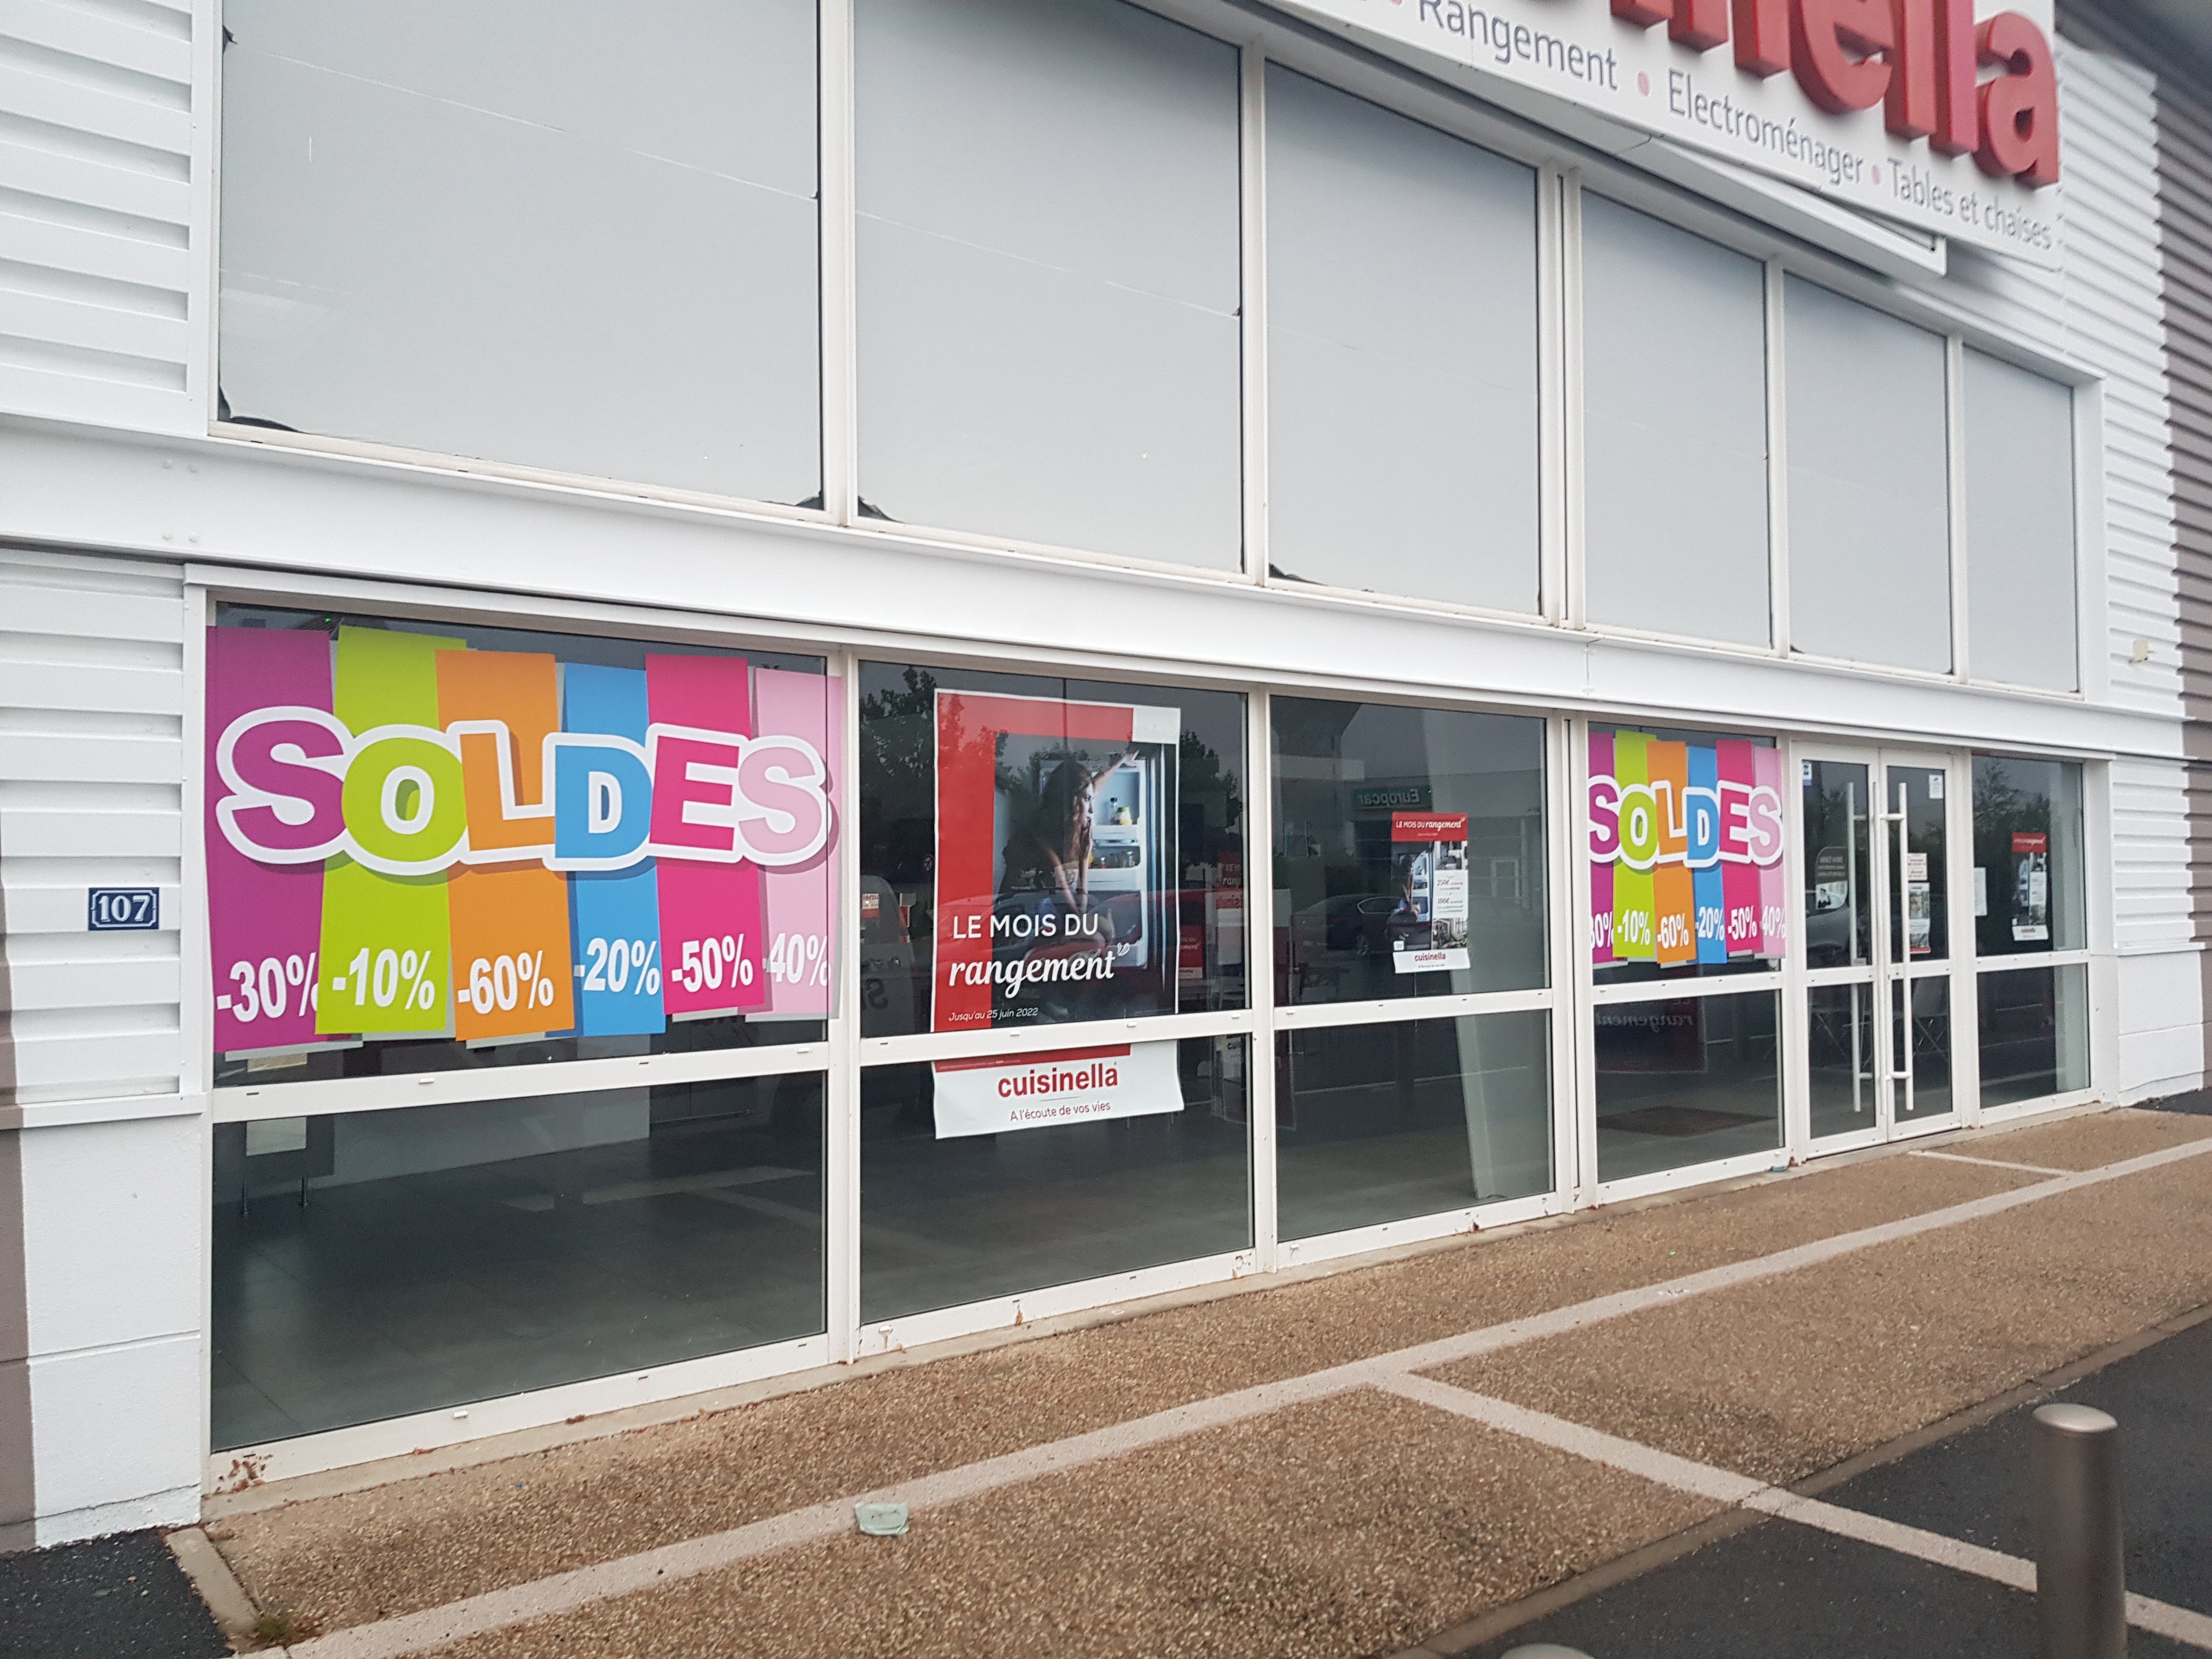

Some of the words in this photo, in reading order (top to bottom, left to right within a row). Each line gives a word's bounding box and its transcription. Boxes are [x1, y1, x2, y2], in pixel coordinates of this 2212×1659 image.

[1668, 67, 1865, 187] Electroménager
[1886, 157, 1954, 217] Tables
[1959, 192, 1979, 225] et
[1984, 194, 2052, 250] chaises
[216, 705, 830, 876] SOLDES
[1587, 775, 1784, 870] SOLDES
[98, 895, 151, 922] 107
[952, 915, 981, 940] LE
[990, 913, 1057, 939] MOIS
[1064, 912, 1099, 936] DU
[1617, 909, 1651, 946] -10%
[1657, 912, 1689, 950] -60%
[1695, 906, 1724, 941] -20%
[1728, 905, 1757, 941] -50%
[1414, 952, 1446, 961] cuisinella
[216, 951, 318, 1024] -30%
[332, 947, 436, 1011] -10%
[457, 950, 555, 1015] -60%
[574, 938, 661, 996] -20%
[671, 933, 753, 994] -50%
[949, 1011, 985, 1022] Jusqu'au
[987, 1009, 998, 1019] 25
[998, 1009, 1014, 1021] juin
[1016, 1007, 1039, 1017] 2022
[998, 1063, 1118, 1098] cuisinella
[1010, 1110, 1018, 1121] A
[1019, 1108, 1057, 1120] l'écoute
[1059, 1104, 1071, 1115] de
[1073, 1105, 1090, 1114] vos
[1092, 1101, 1111, 1111] vies
